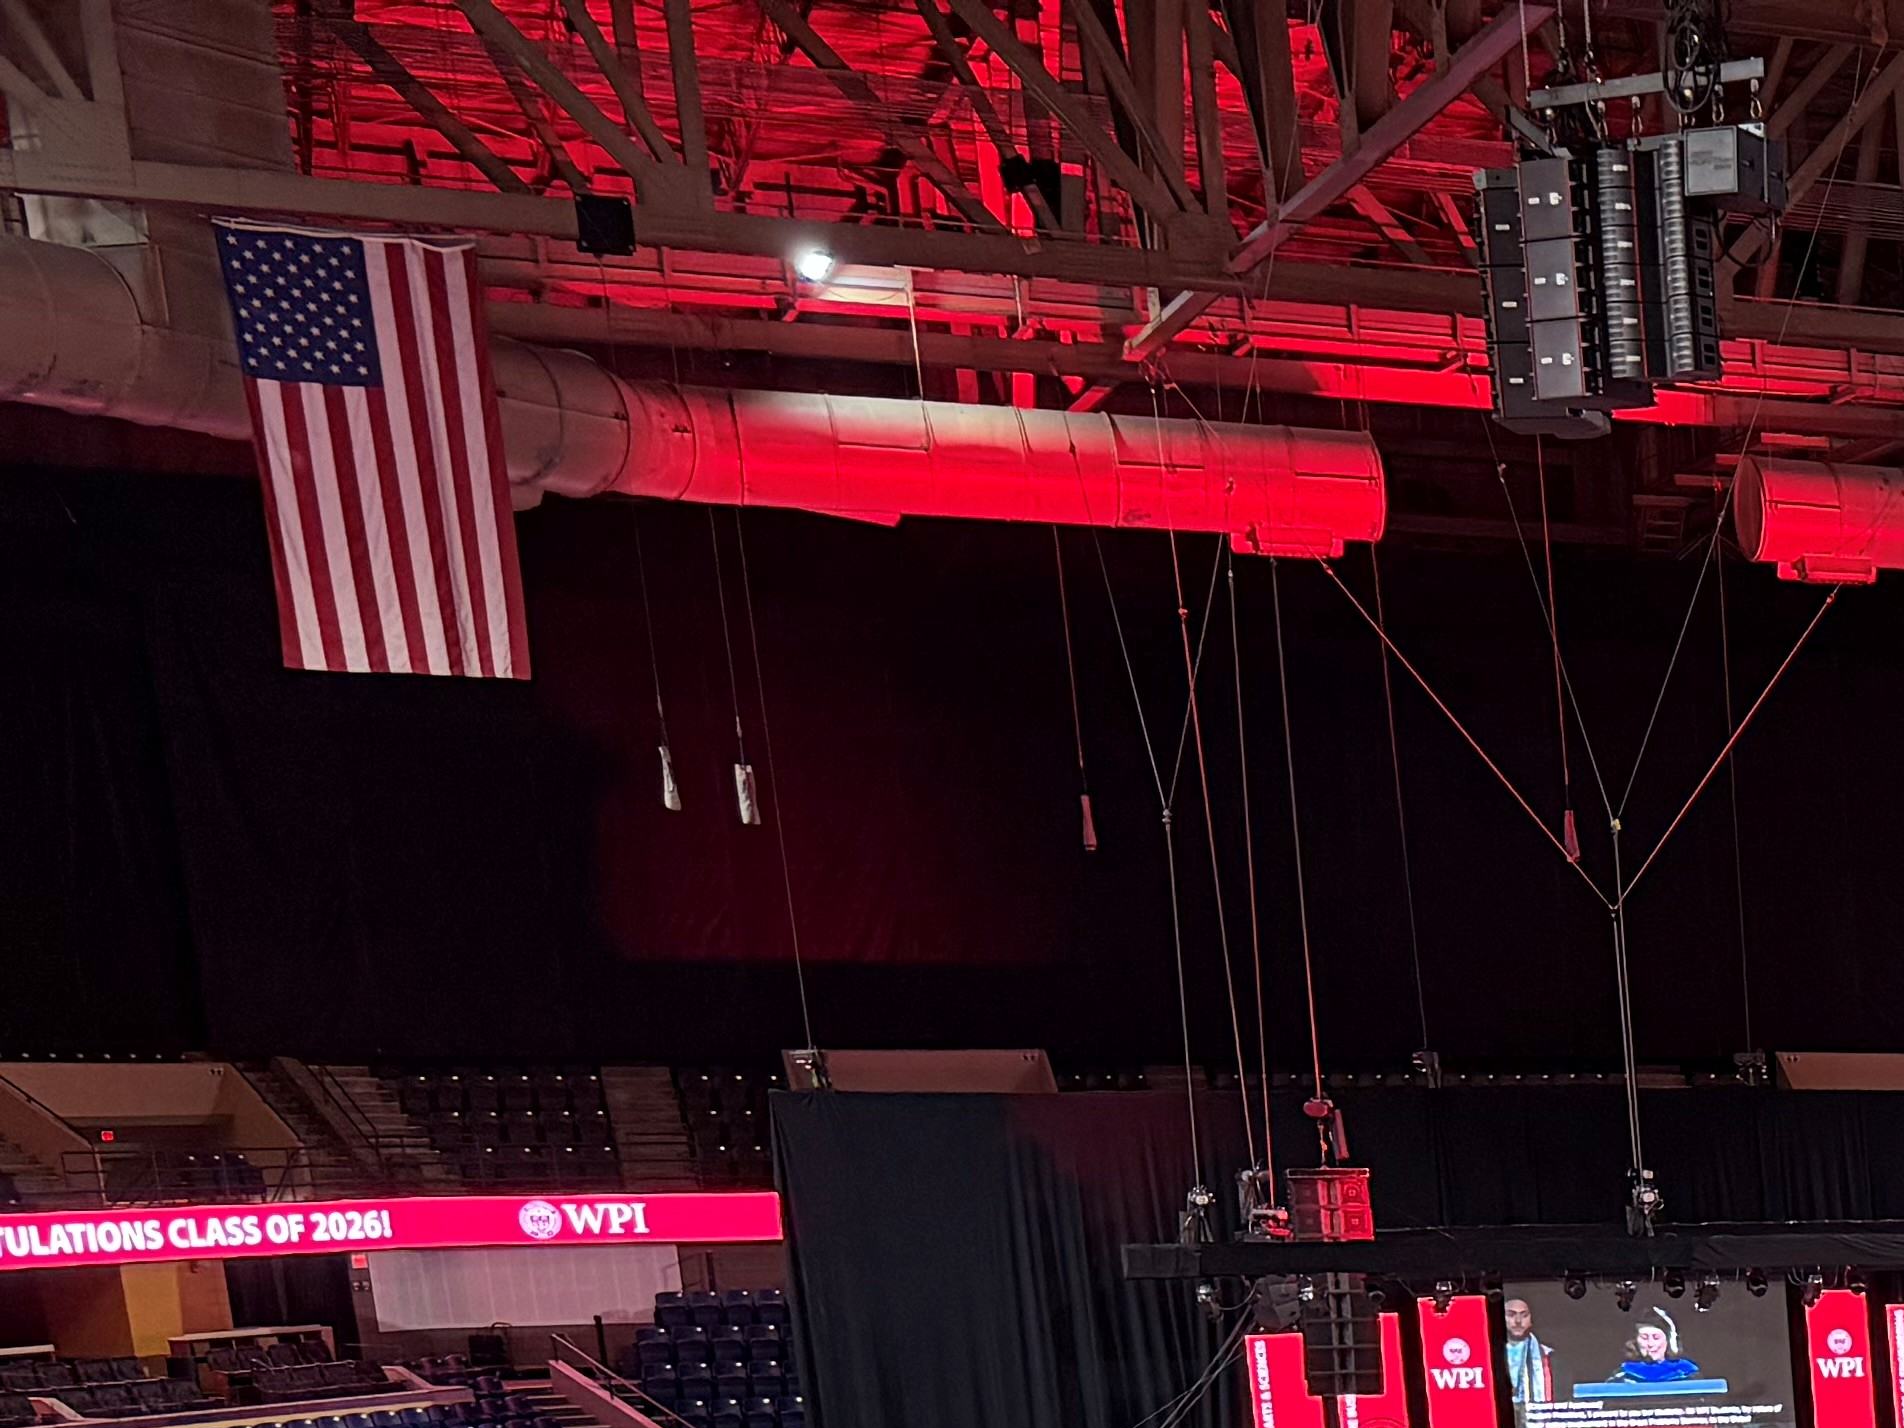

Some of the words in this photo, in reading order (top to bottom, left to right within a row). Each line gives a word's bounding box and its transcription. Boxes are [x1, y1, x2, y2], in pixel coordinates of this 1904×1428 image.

[168, 1214, 263, 1249] CLASS
[266, 1213, 305, 1243] OF
[310, 1209, 393, 1242] 2026!
[561, 1202, 651, 1235] WPI
[1430, 1367, 1485, 1390] WPI
[1816, 1356, 1866, 1379] WPI
